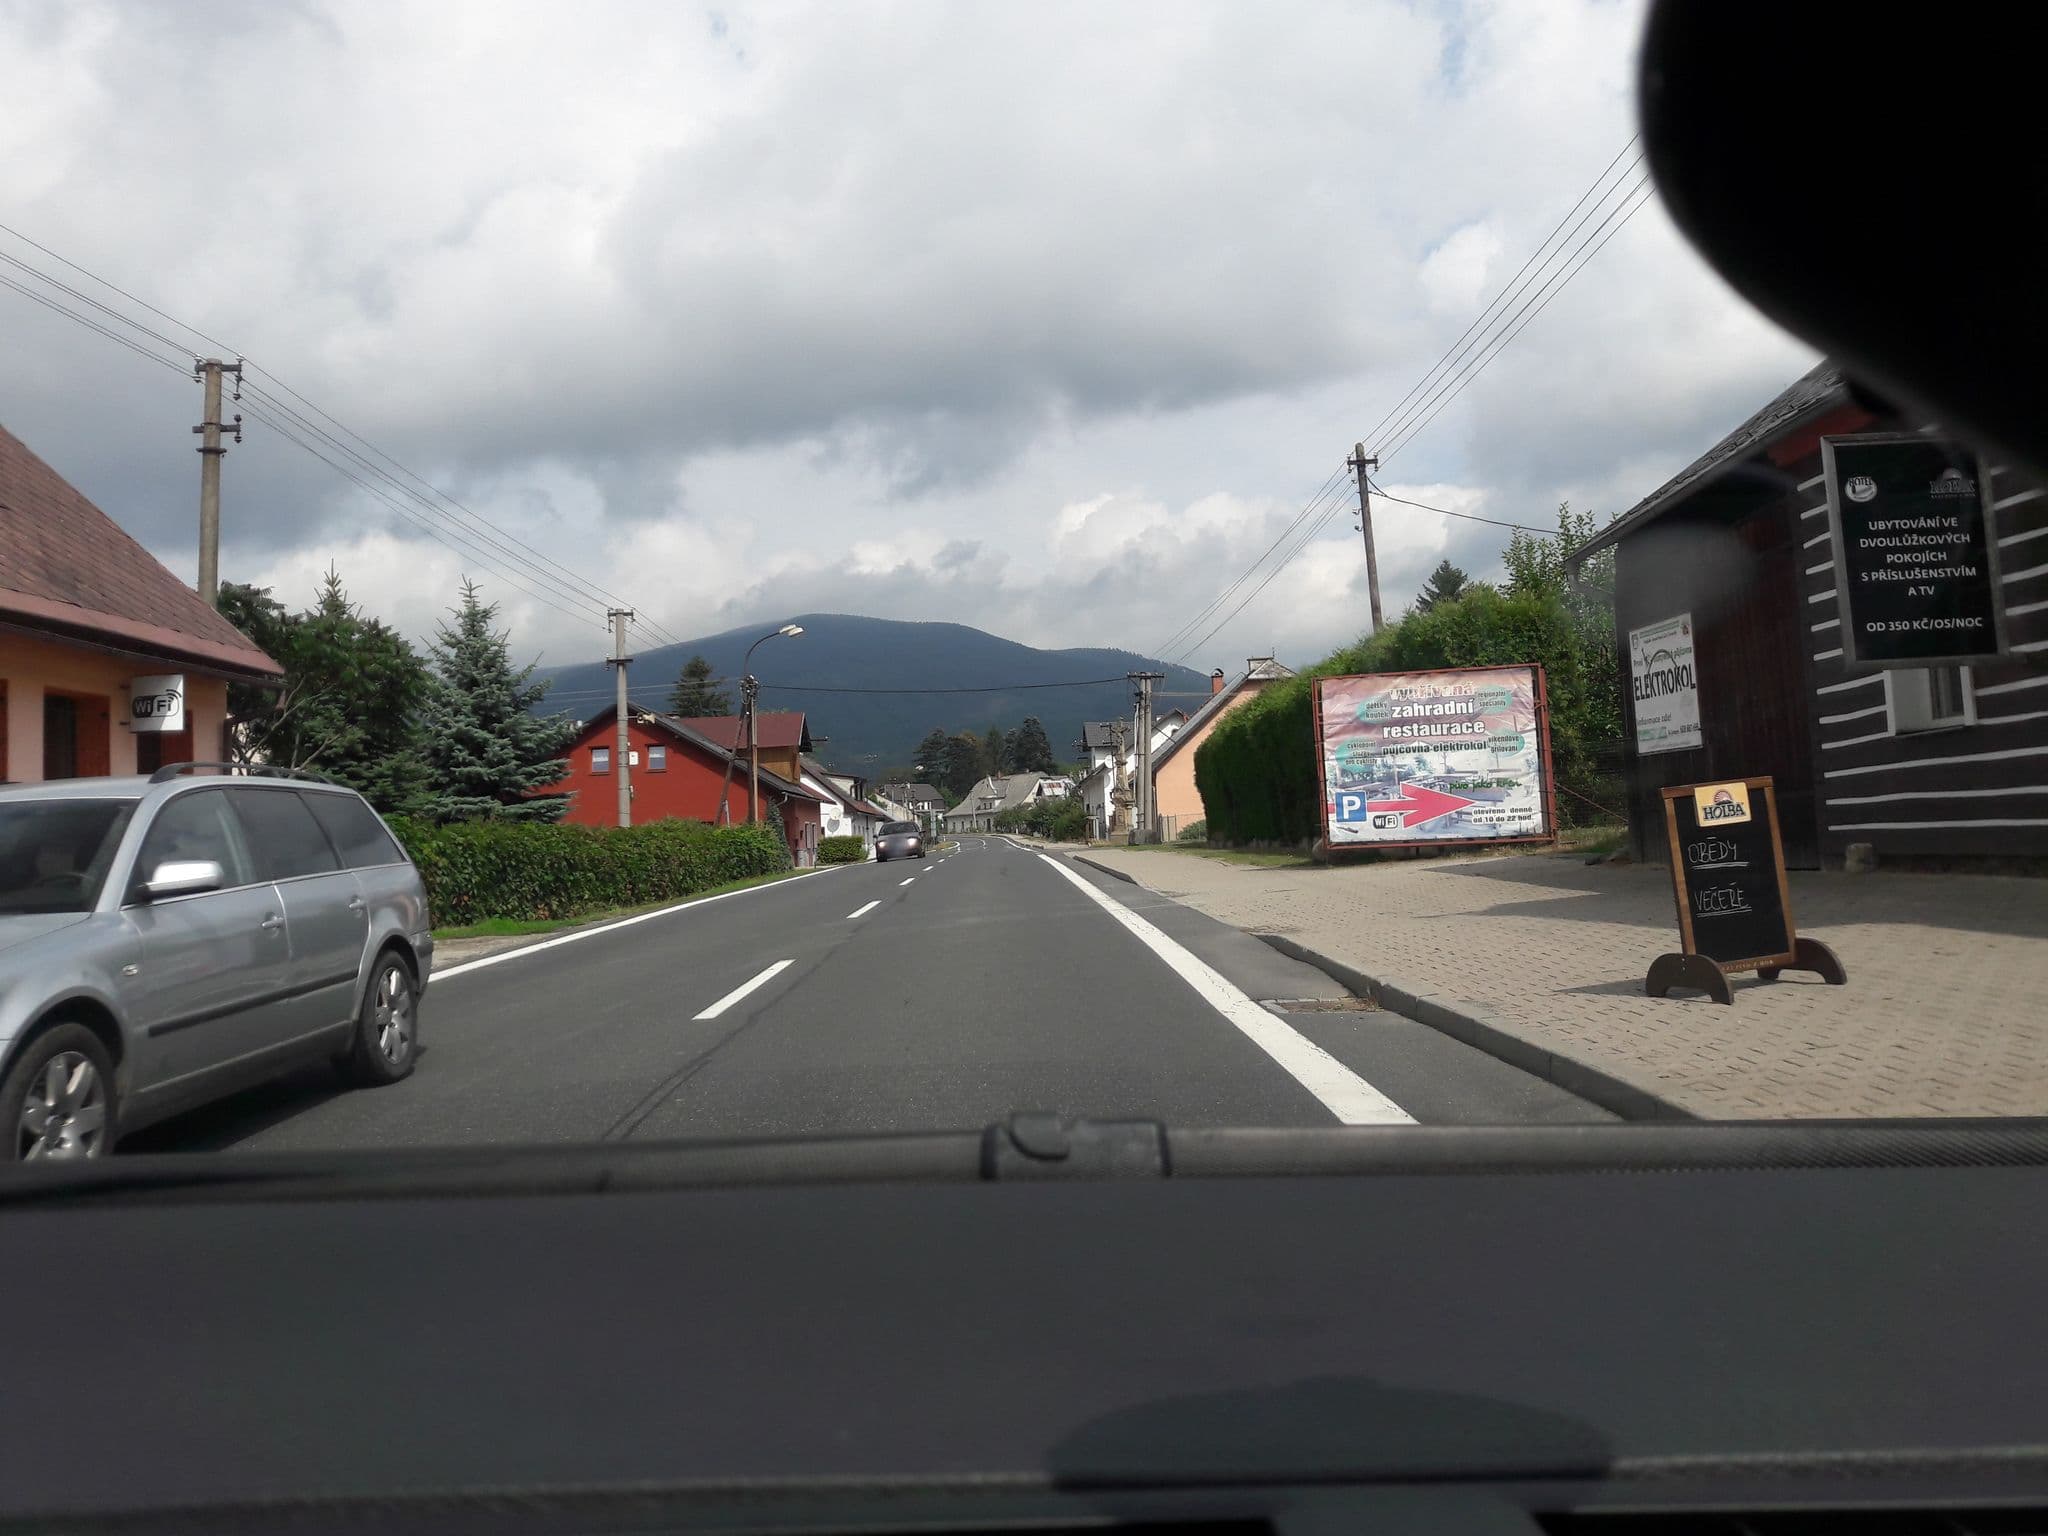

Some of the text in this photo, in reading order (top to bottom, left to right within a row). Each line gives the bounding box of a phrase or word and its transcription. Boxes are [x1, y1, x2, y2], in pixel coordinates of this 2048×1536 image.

[1869, 516, 1958, 531] UBYTOVÁNÍ VE
[1860, 532, 1970, 548] DVOULŮŽKOVÝCH
[1886, 550, 1947, 563] POKOJÍCH
[1861, 565, 1977, 582] S PŘÍSLUŠENSTVÍM
[1908, 585, 1935, 597] A TV
[1866, 616, 1983, 632] OD 350 KČ/OS/NOC
[1633, 663, 1697, 701] ELEKTROKOL
[1390, 698, 1475, 719] zahradní
[1382, 720, 1486, 740] restaurace
[1449, 782, 1469, 794] pivo
[1342, 796, 1361, 819] P
[1703, 803, 1745, 820] HOLBA
